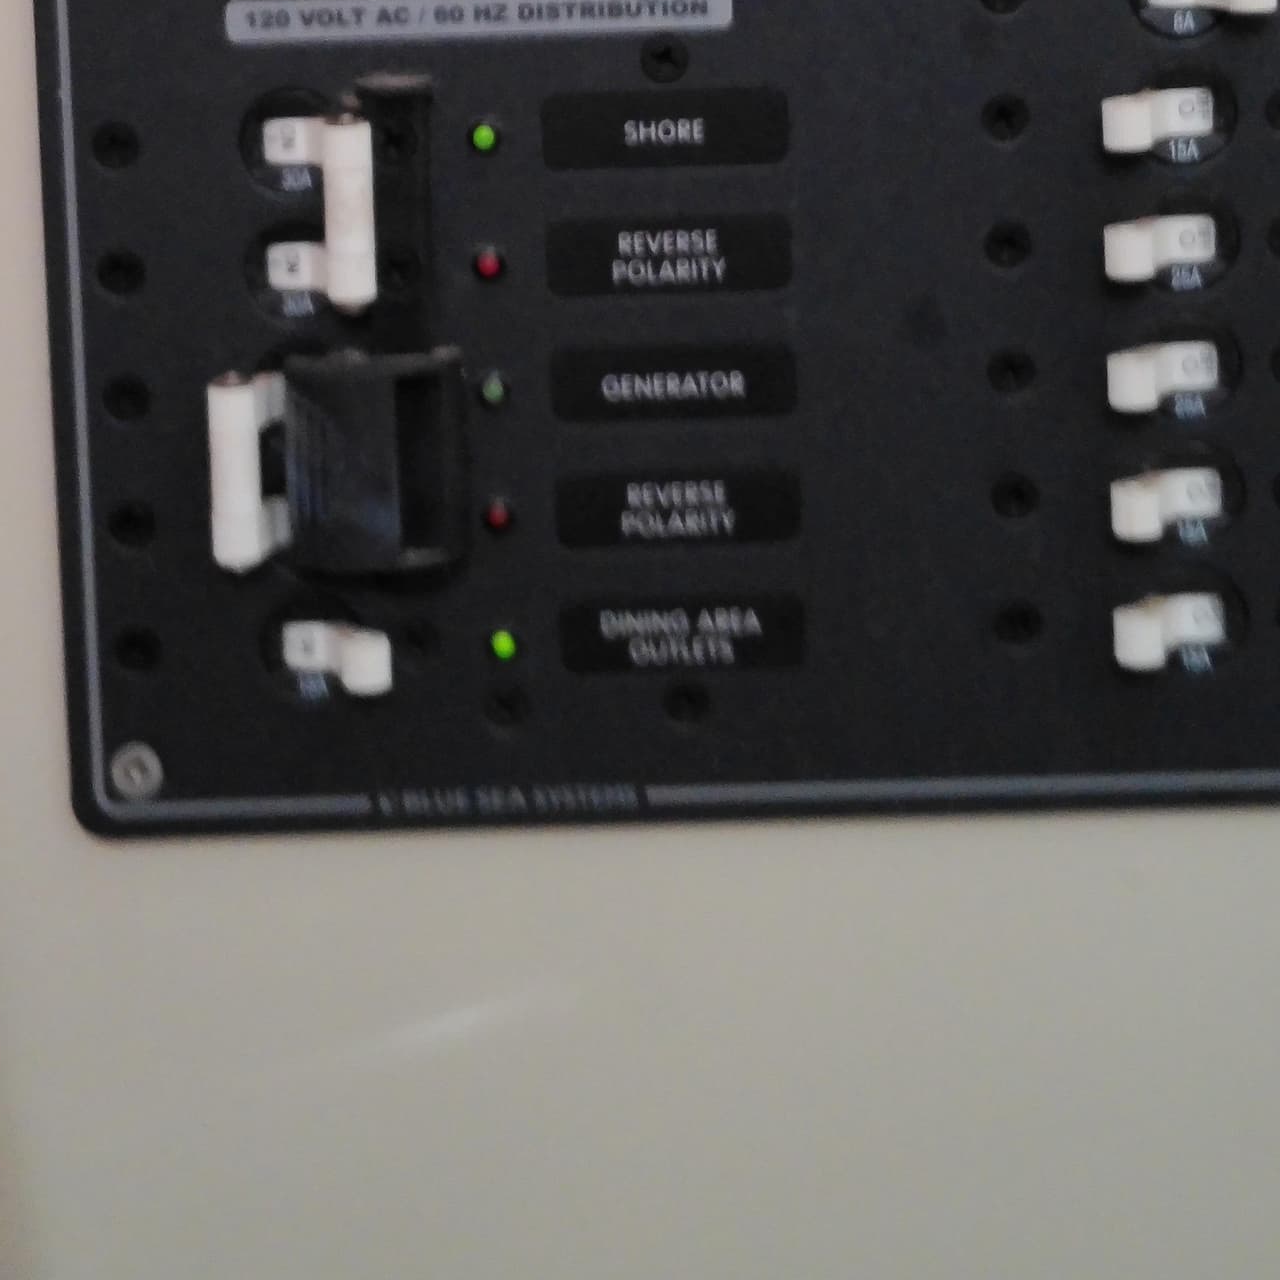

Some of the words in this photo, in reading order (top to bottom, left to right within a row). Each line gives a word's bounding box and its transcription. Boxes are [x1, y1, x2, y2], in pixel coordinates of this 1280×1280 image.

[246, 8, 291, 30] 120
[299, 6, 366, 28] VOLT
[375, 5, 411, 26] AC
[432, 3, 466, 26] 60
[473, 2, 509, 24] HZ
[624, 118, 705, 147] SHORE
[617, 228, 719, 256] REVERSE
[611, 256, 727, 286] POLARITY
[600, 370, 747, 403] GENERATOR
[626, 479, 725, 508] REVERSE
[621, 508, 736, 539] POLARITY
